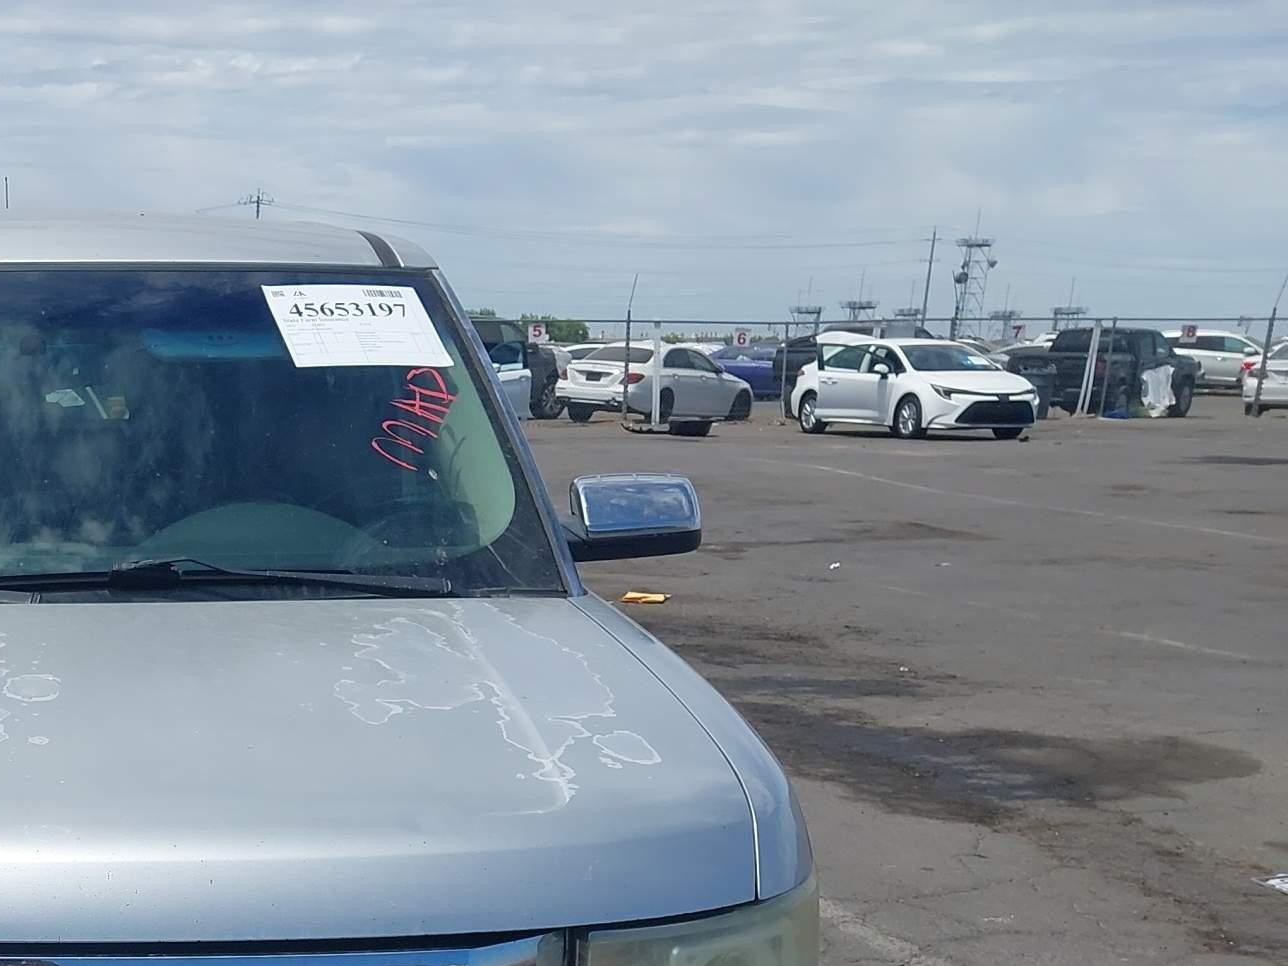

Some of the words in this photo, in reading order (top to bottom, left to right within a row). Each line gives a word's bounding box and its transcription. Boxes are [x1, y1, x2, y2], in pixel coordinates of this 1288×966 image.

[289, 302, 406, 318] 45653197
[532, 324, 542, 337] 5
[1012, 324, 1023, 338] 7
[737, 332, 747, 345] 6
